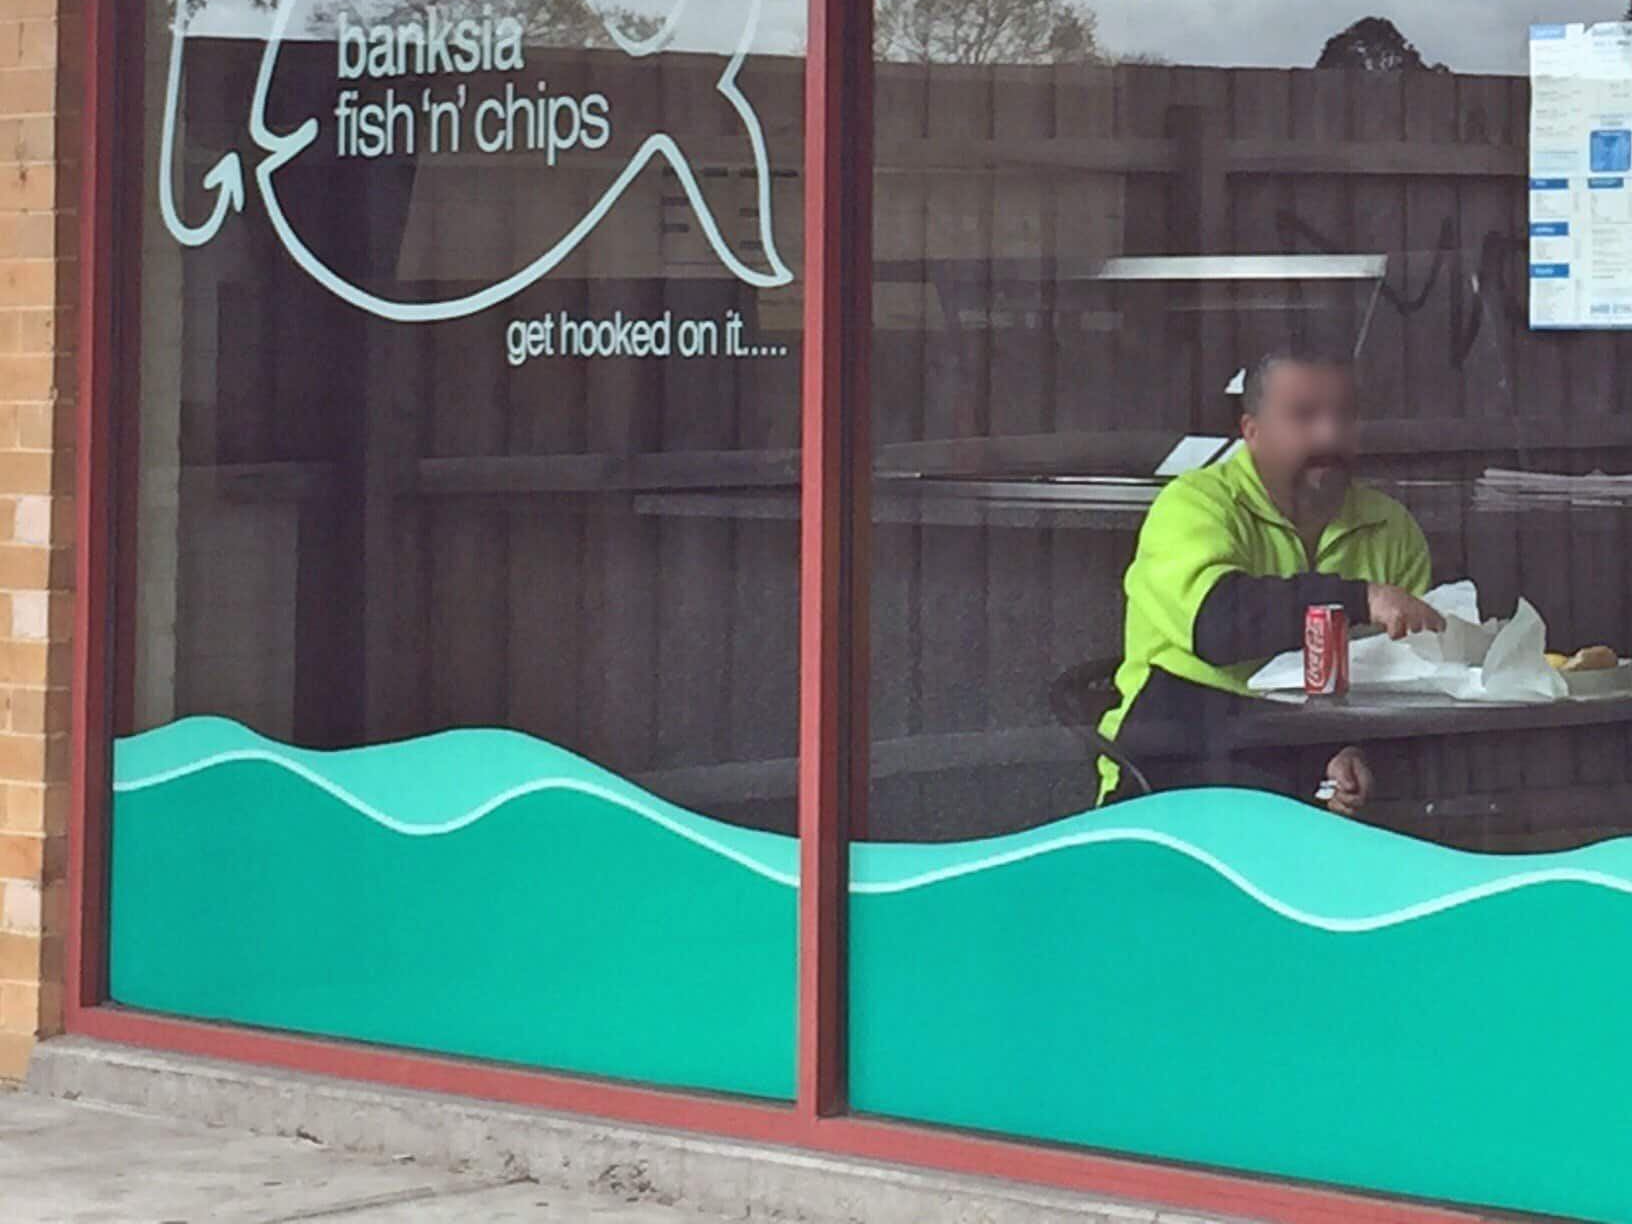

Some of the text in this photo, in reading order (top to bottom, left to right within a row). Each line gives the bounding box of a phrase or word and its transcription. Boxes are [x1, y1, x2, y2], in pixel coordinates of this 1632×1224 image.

[337, 5, 525, 78] banksia
[334, 88, 414, 157] fish
[474, 80, 611, 166] chips
[506, 312, 555, 365] get
[560, 310, 671, 356] hooked
[677, 320, 717, 357] on
